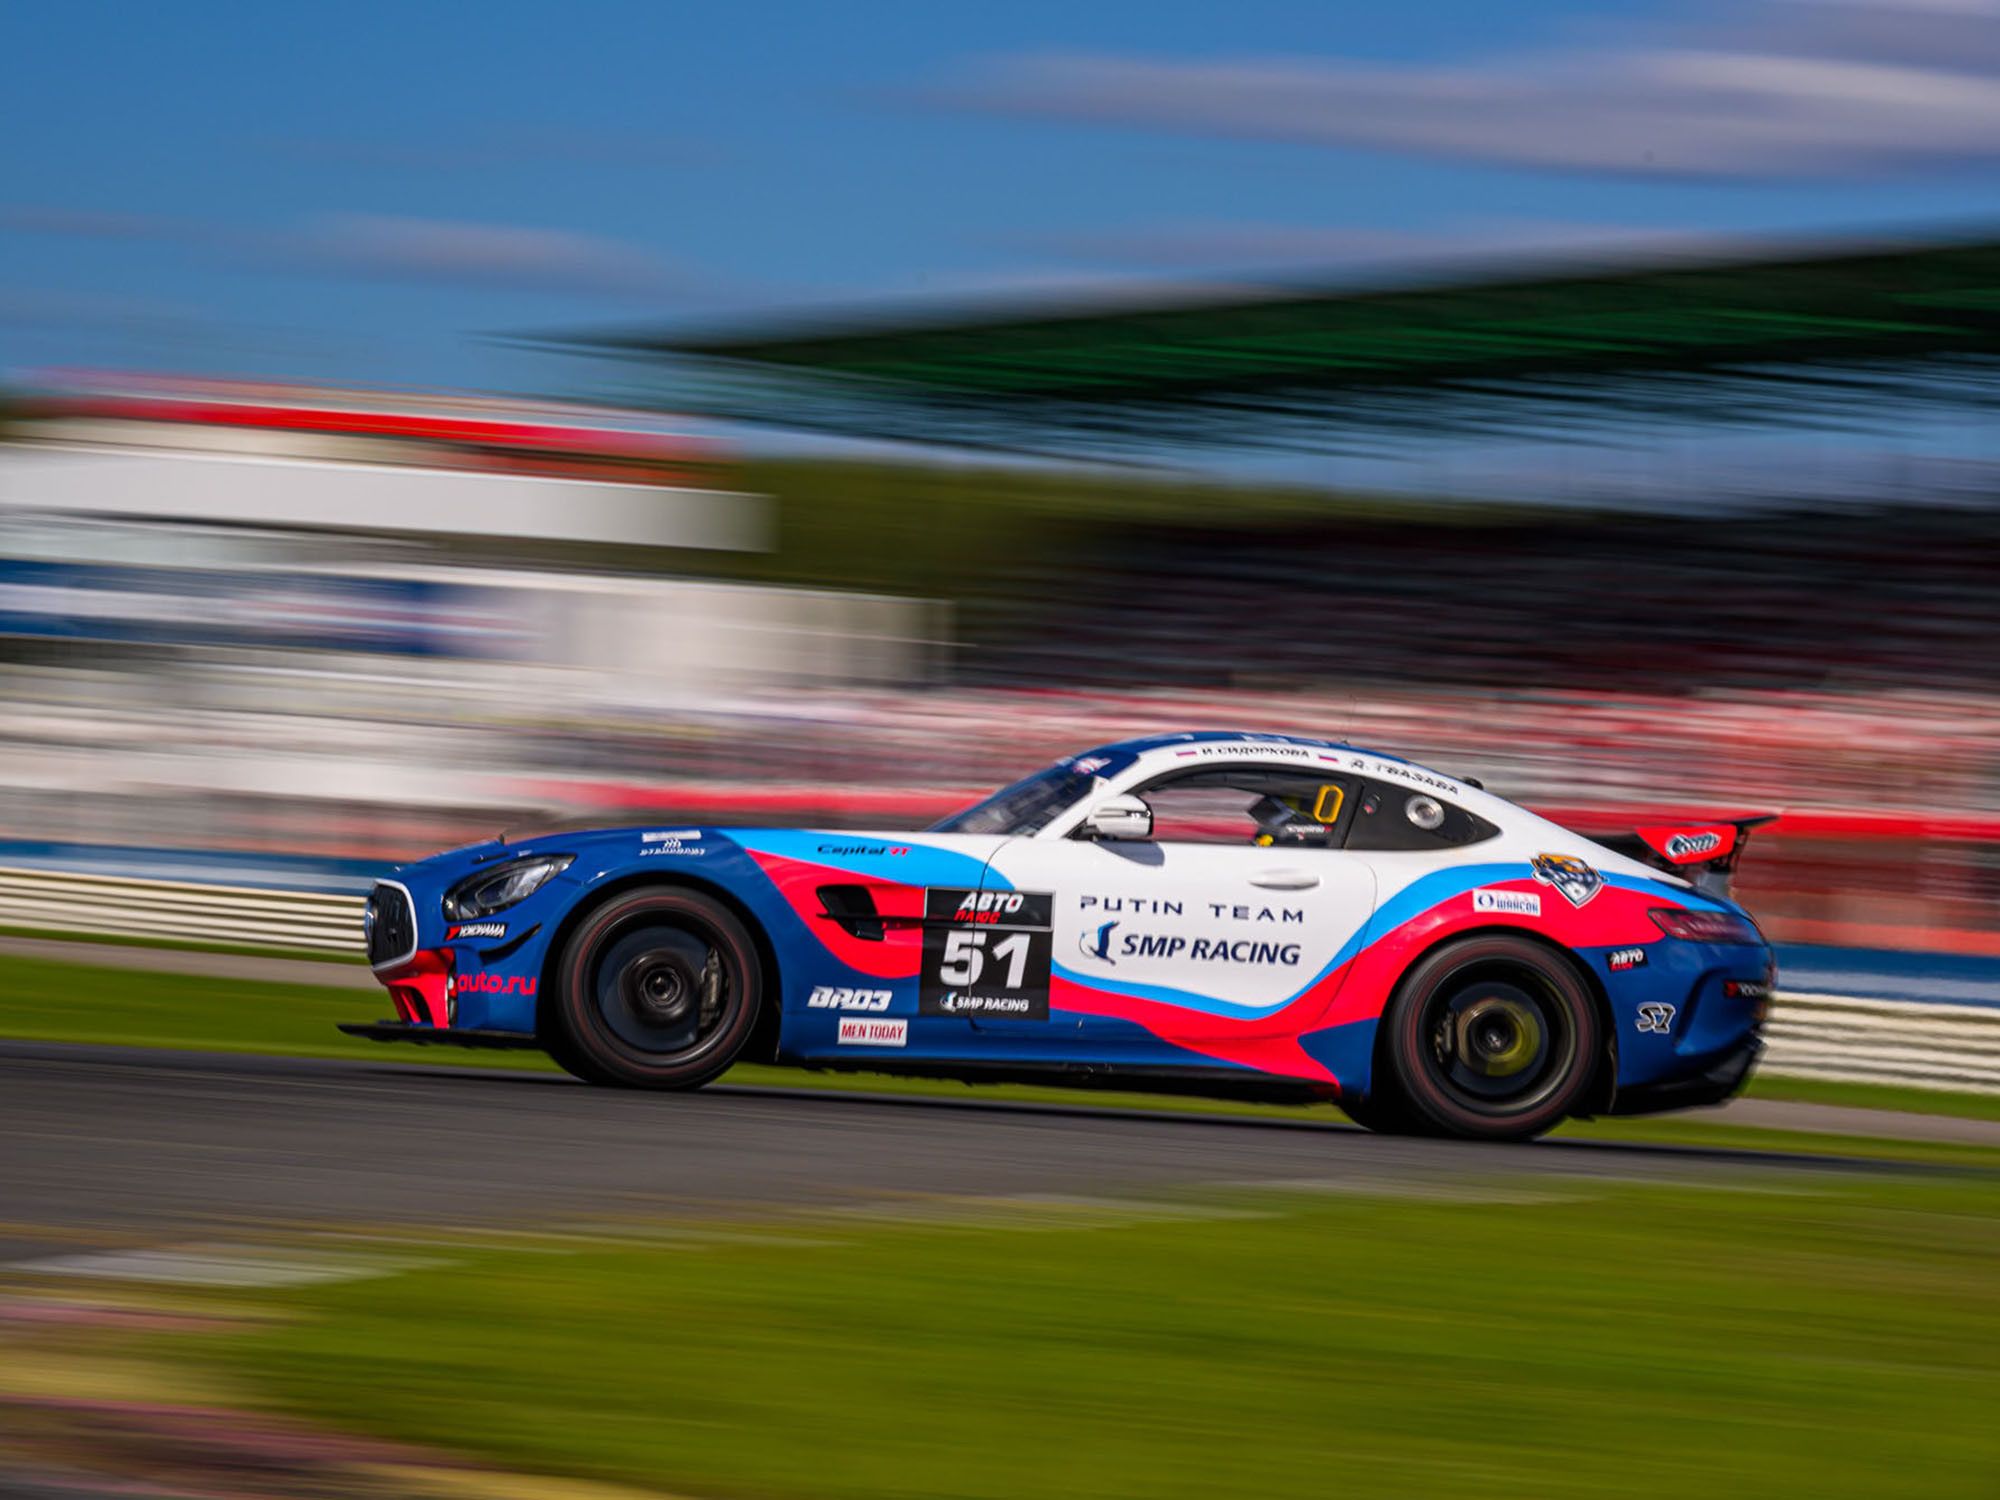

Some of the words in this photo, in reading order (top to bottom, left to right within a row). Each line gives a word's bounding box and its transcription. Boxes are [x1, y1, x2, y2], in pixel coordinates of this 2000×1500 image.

[817, 845, 886, 856] Capital
[959, 892, 1024, 913] АВТО
[1080, 896, 1183, 916] PUTIN
[1209, 903, 1303, 923] TEAM
[459, 924, 506, 938] YOKOHAMA
[941, 930, 1031, 988] 51
[1121, 934, 1185, 959] SMP
[1191, 938, 1301, 965] RACING
[1610, 948, 1644, 964] АВТО
[457, 971, 537, 996] auto.ru
[956, 996, 983, 1009] SMP
[983, 998, 1029, 1012] RACING
[841, 1023, 867, 1038] MEN
[869, 1025, 904, 1040] TODAY
